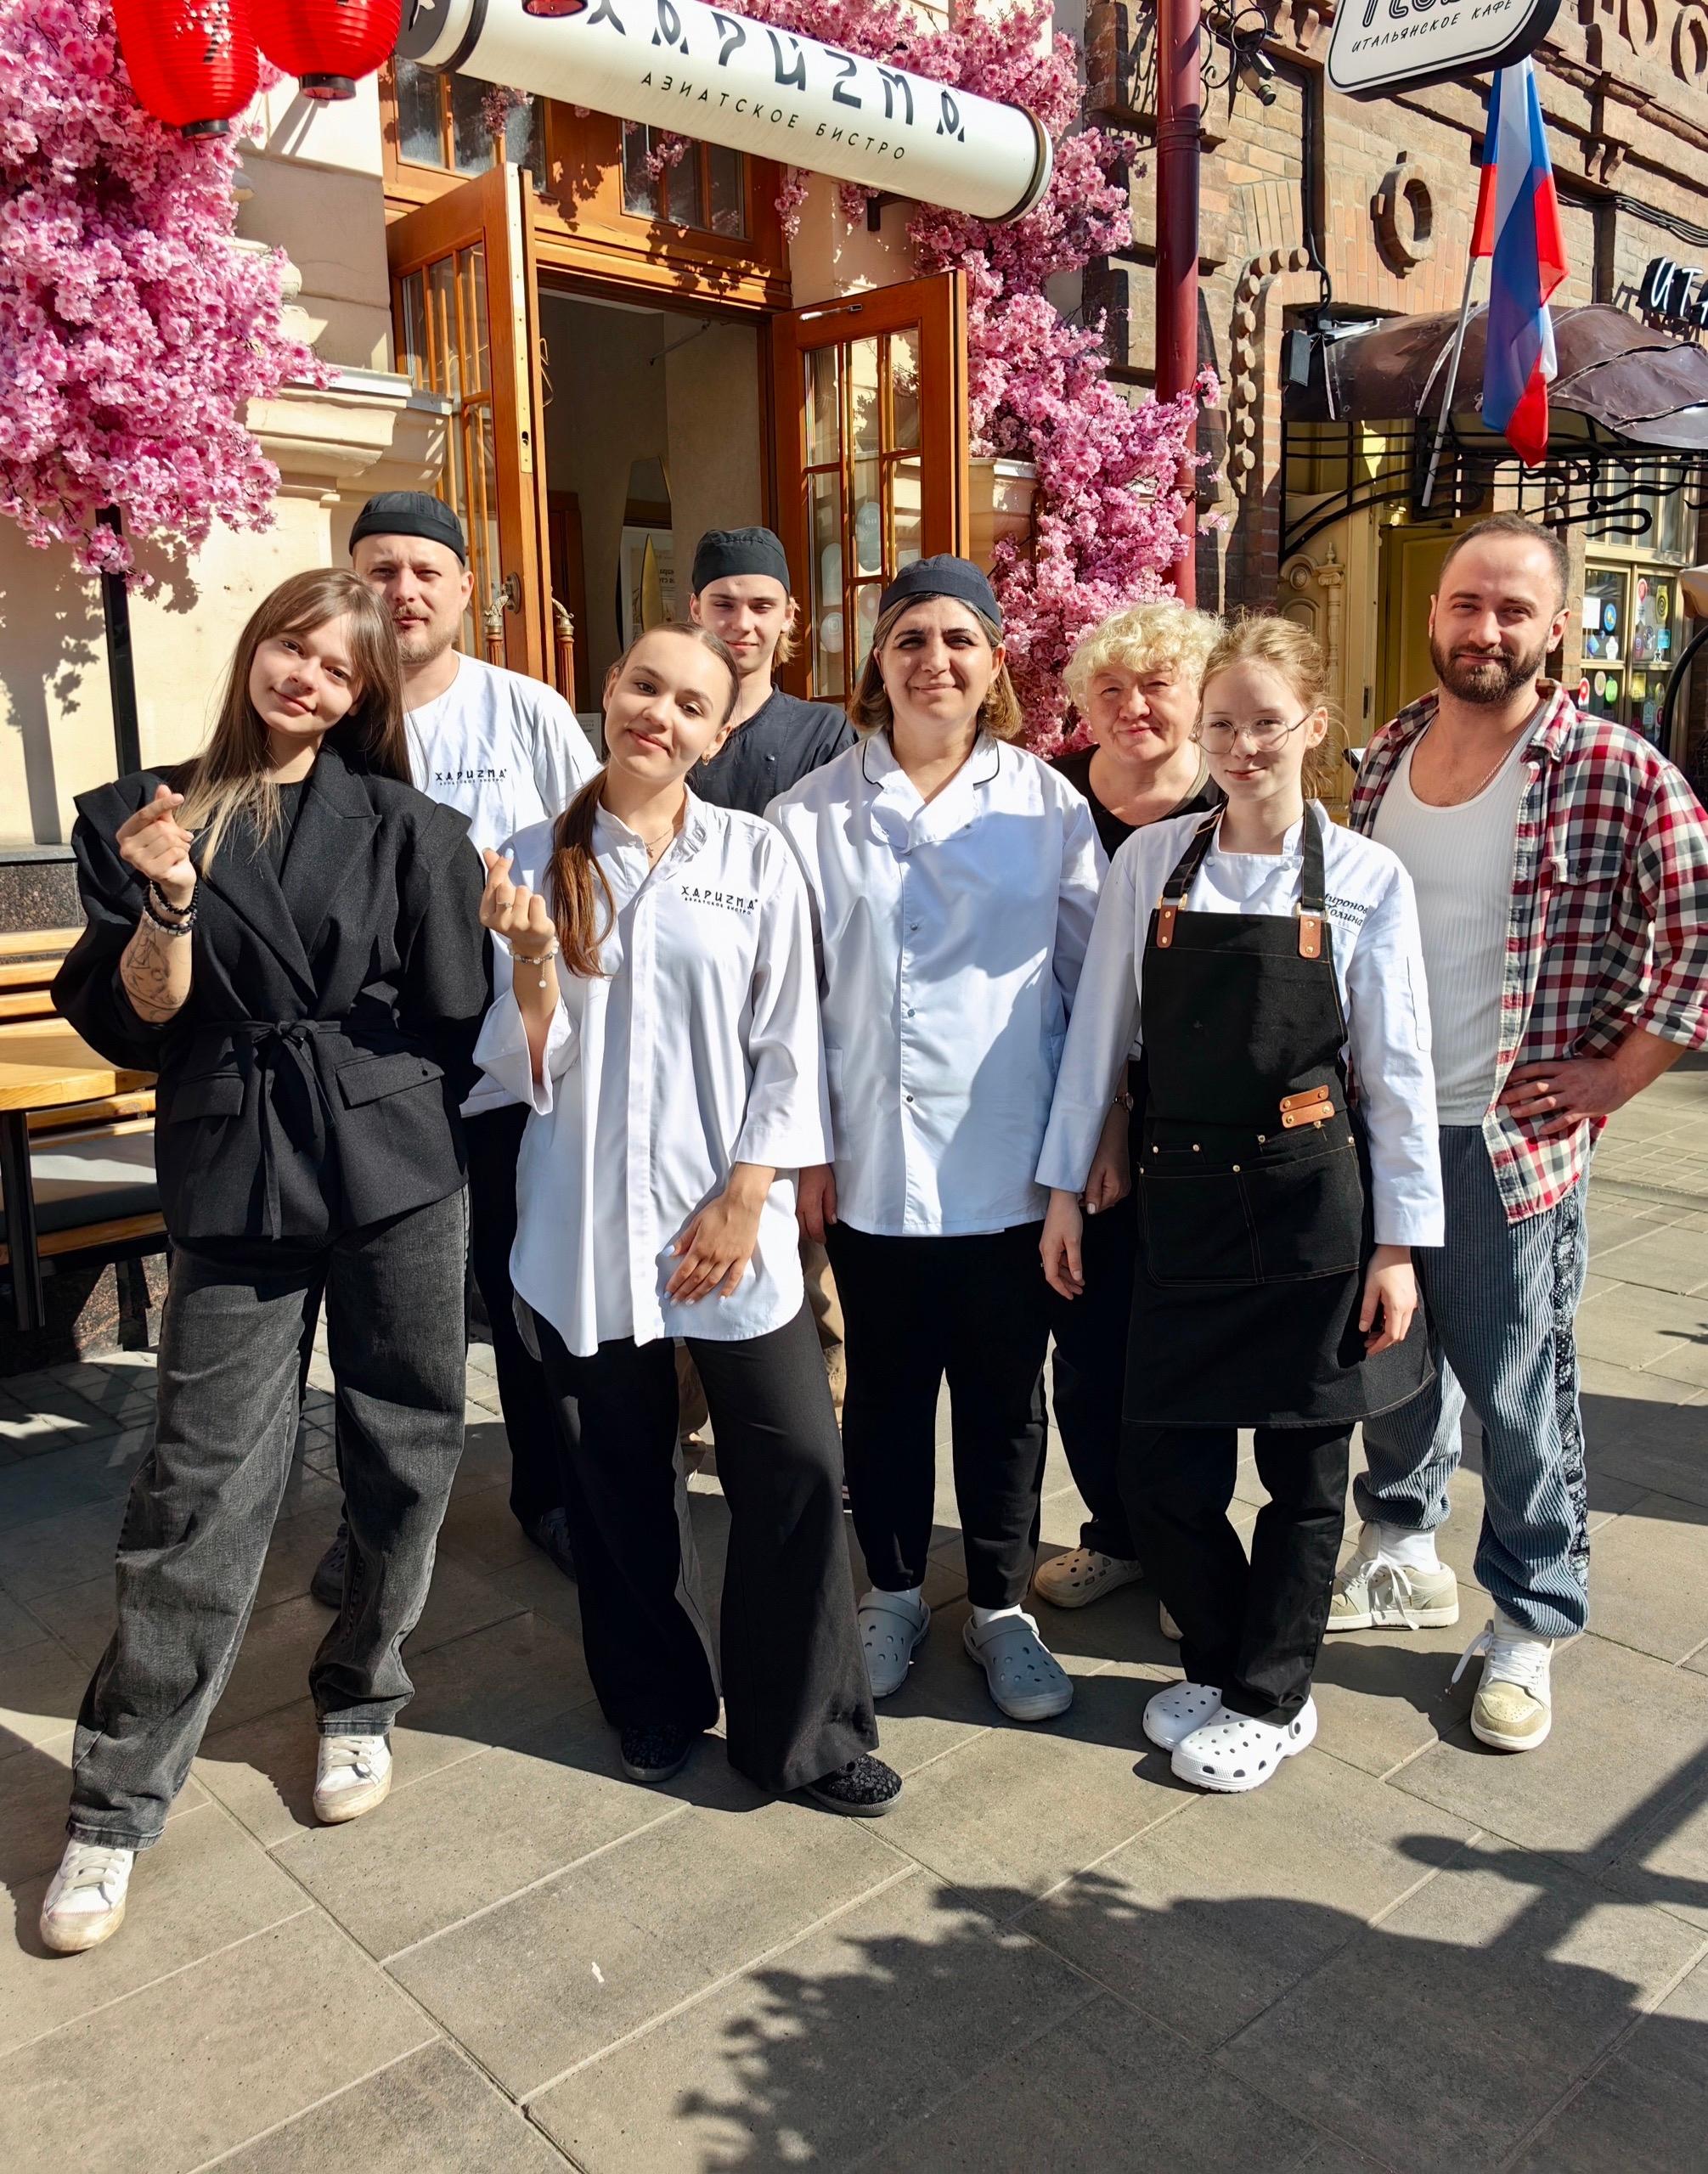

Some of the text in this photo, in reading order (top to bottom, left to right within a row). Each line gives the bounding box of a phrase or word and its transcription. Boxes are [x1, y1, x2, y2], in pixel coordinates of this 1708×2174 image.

[1351, 12, 1461, 53] ИТАЛЬЯНСКОЕ
[1471, 0, 1512, 20] КАФЕ
[641, 70, 905, 160] АЗИАТСКОЕ БИСТРО
